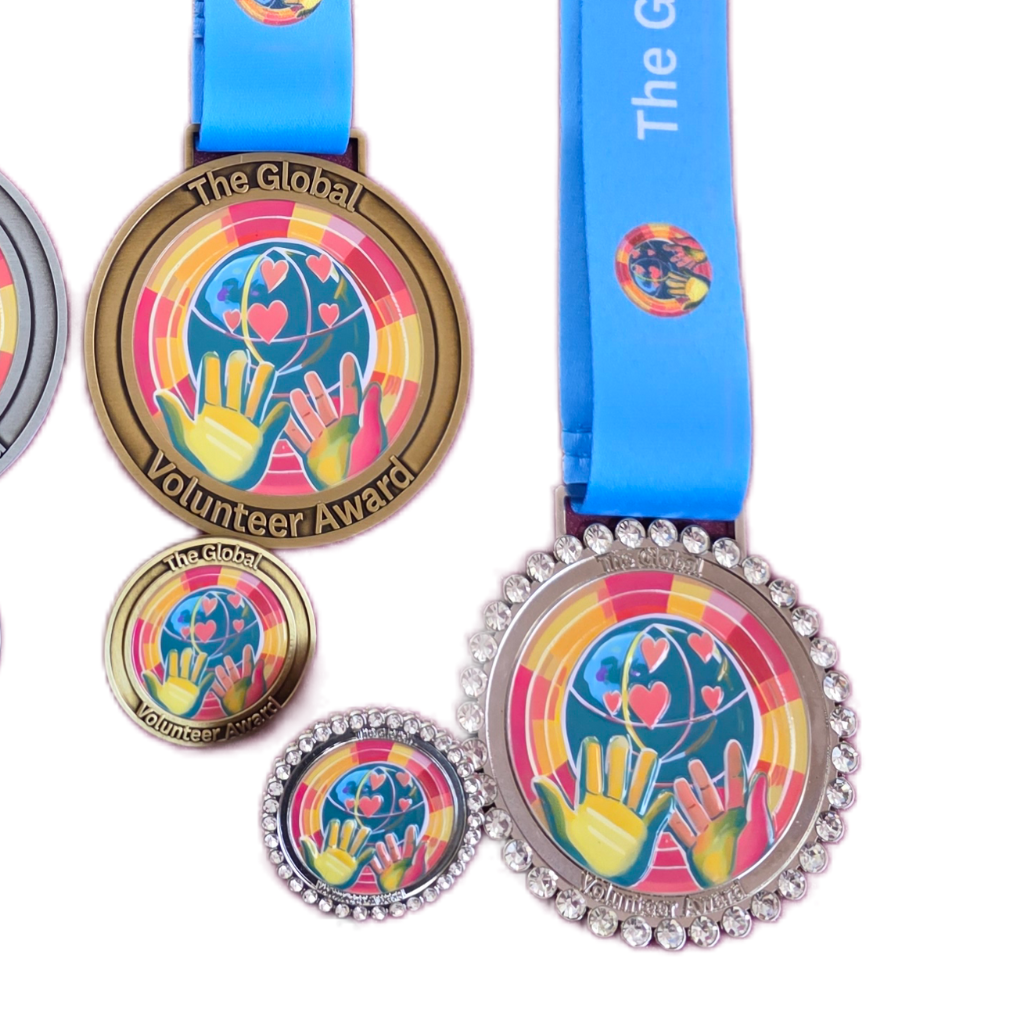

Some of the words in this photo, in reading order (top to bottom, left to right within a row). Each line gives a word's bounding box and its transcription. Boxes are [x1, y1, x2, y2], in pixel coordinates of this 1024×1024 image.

[631, 47, 679, 140] The
[188, 167, 249, 207] The
[256, 160, 365, 212] Global
[145, 450, 303, 537] Volunteer
[314, 456, 416, 535] Award
[163, 551, 199, 573] The
[202, 543, 262, 571] Global
[136, 702, 221, 742] Volunteer
[225, 696, 282, 740] Award
